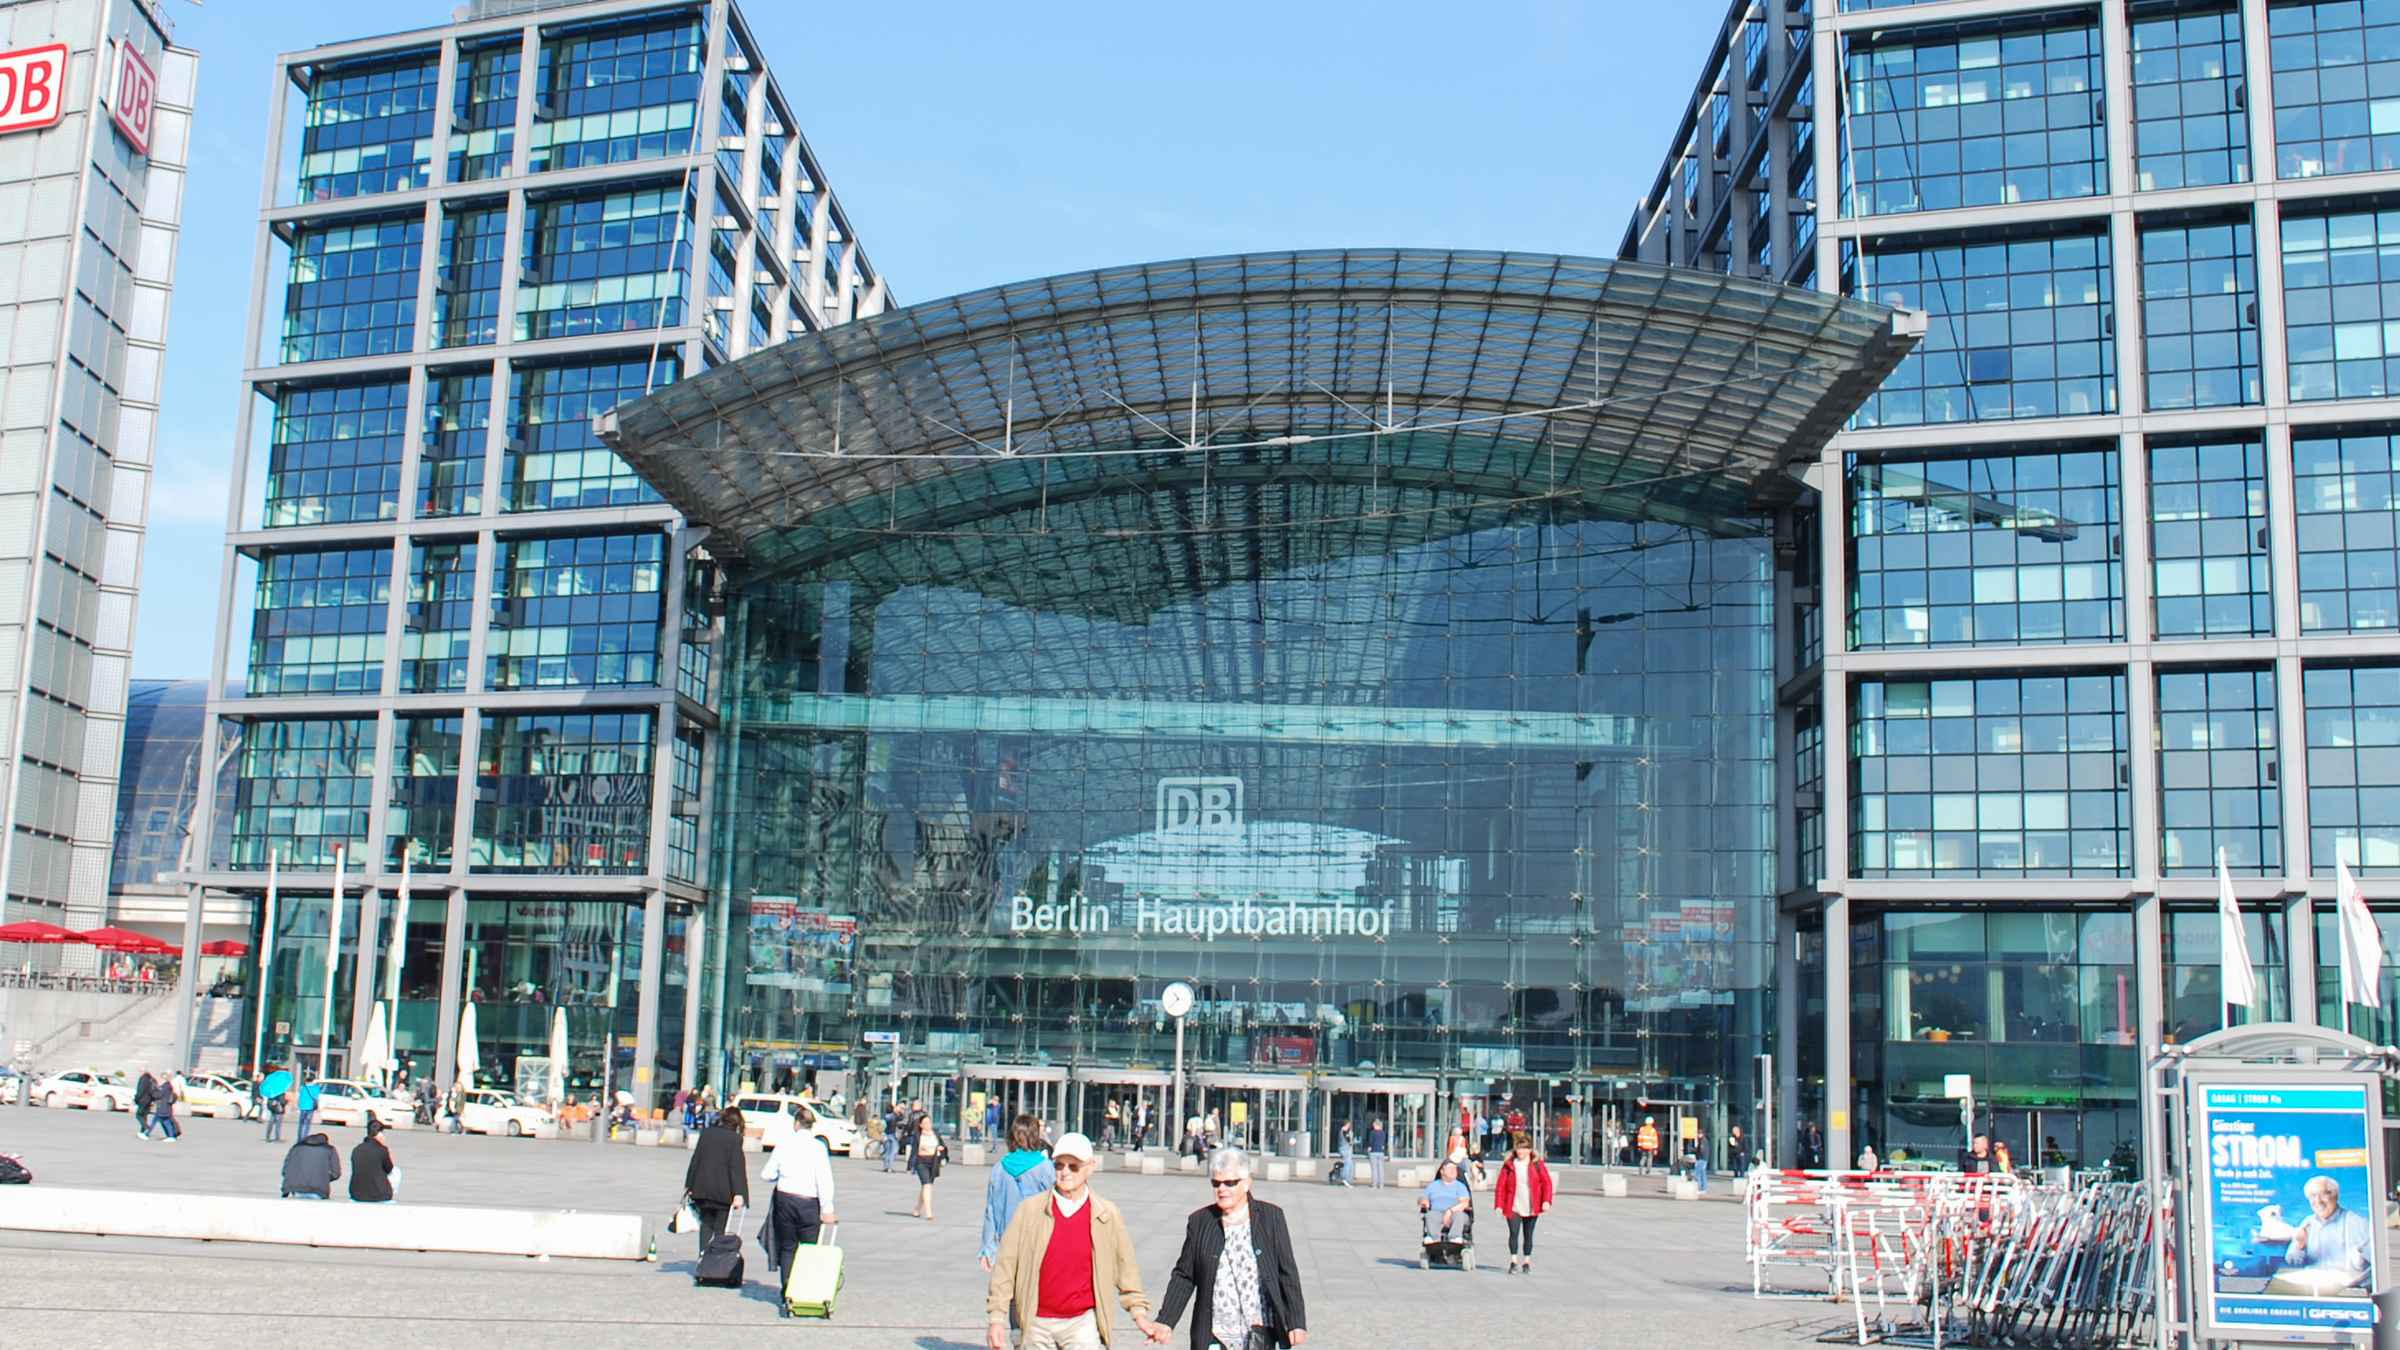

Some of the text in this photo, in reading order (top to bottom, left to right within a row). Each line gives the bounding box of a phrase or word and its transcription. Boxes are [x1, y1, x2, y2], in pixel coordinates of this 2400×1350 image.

[120, 57, 149, 134] DB
[1168, 787, 1232, 834] DB
[1010, 895, 1394, 942] Berlin Hauptbahnhof
[2211, 1134, 2311, 1168] STROM.
[2308, 1308, 2370, 1321] GASAG
